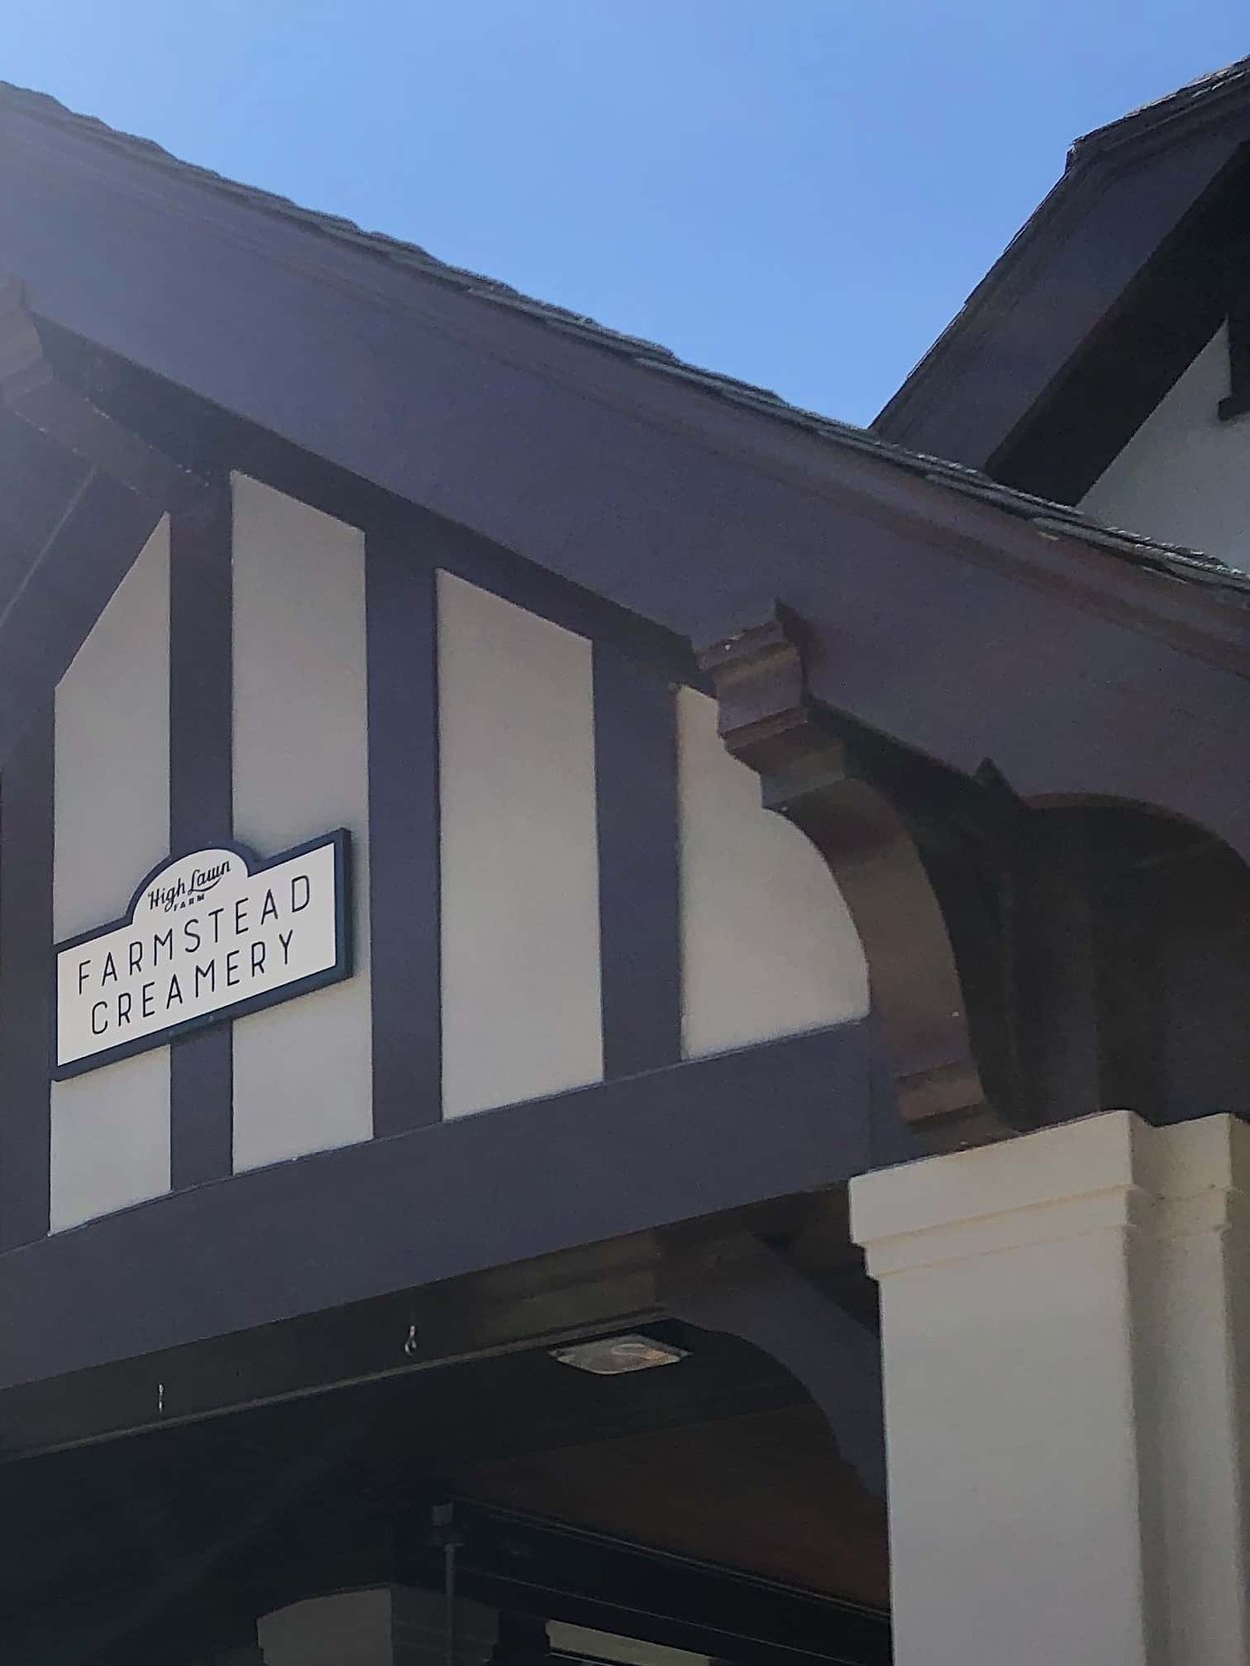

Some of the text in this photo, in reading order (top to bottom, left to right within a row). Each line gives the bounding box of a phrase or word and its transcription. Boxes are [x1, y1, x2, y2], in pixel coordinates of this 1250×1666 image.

[147, 861, 231, 912] High Lawn
[173, 893, 205, 912] FARM
[78, 875, 311, 995] FARMSTEAD
[91, 929, 294, 1035] CREAMERY
